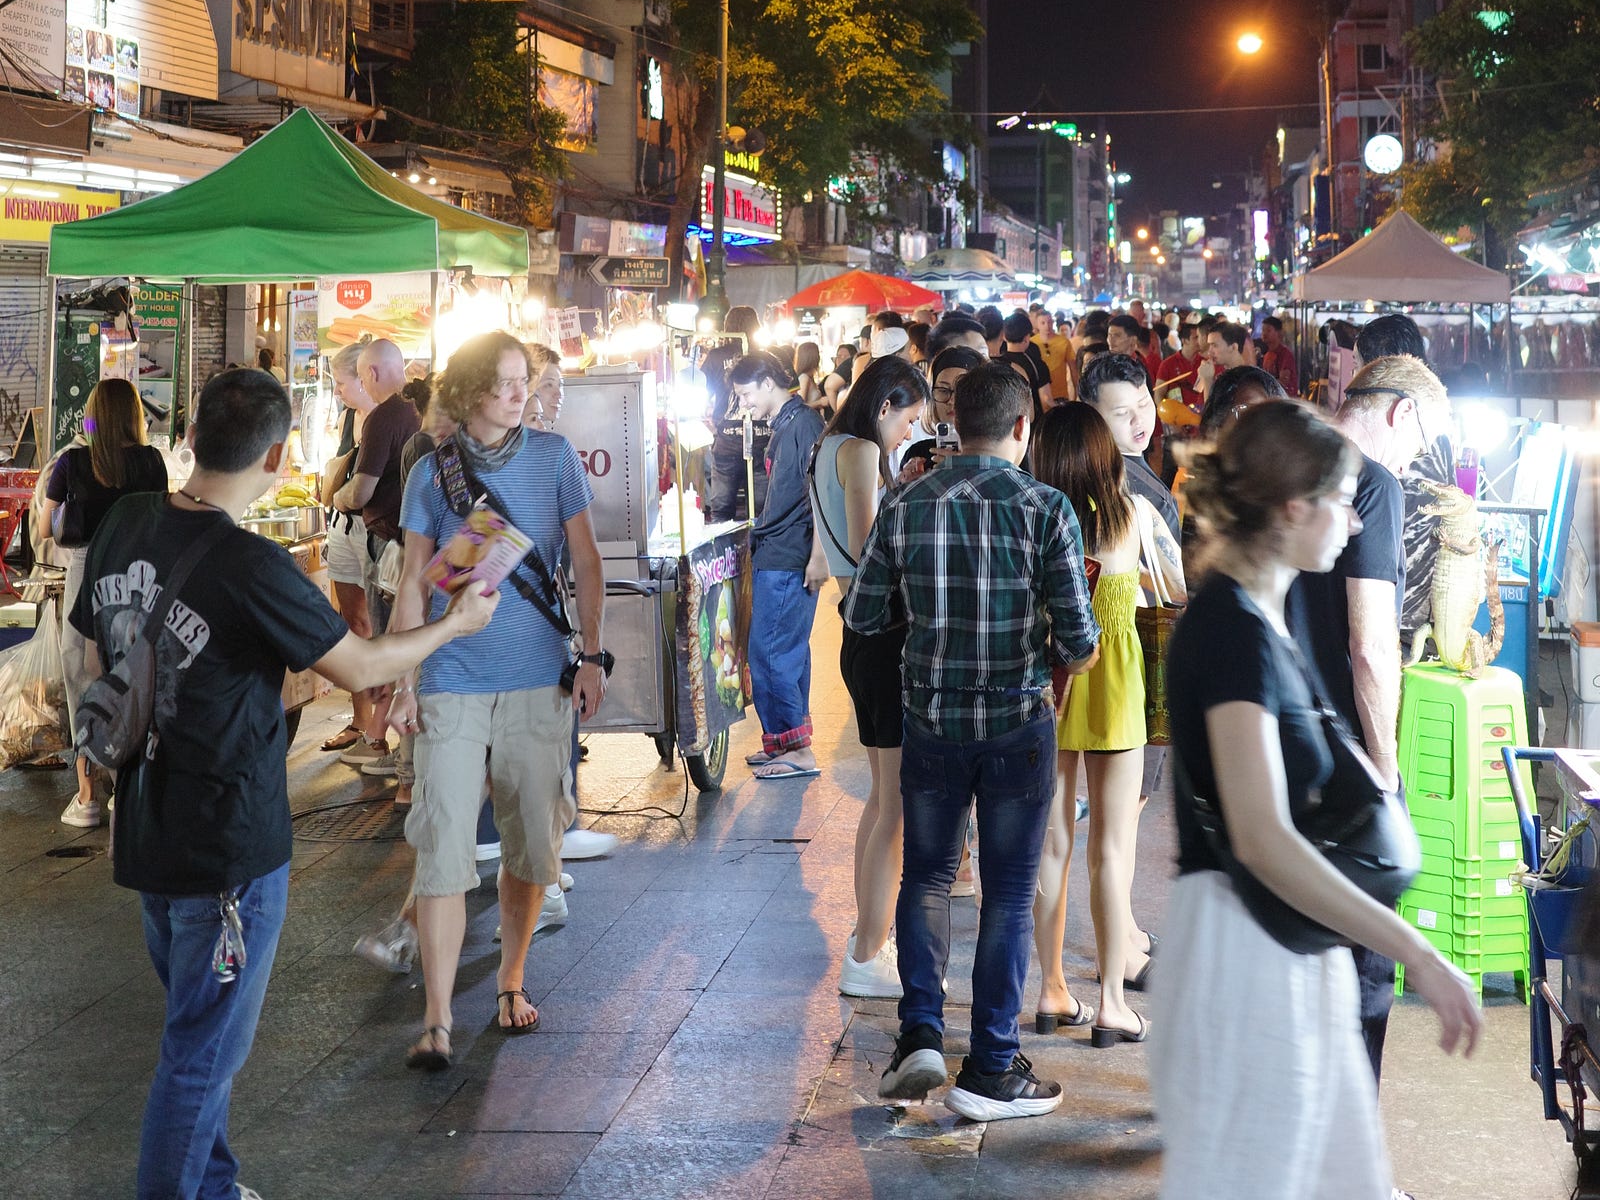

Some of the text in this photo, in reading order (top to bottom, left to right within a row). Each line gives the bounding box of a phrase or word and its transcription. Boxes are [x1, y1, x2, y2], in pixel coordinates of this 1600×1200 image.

[2, 8, 29, 23] CHEAPEST
[34, 16, 51, 30] CLEAN
[1, 23, 52, 42] SHARED BATHROOM
[27, 42, 49, 56] SERVICE
[5, 197, 118, 223] INTERNATIONAL TAI
